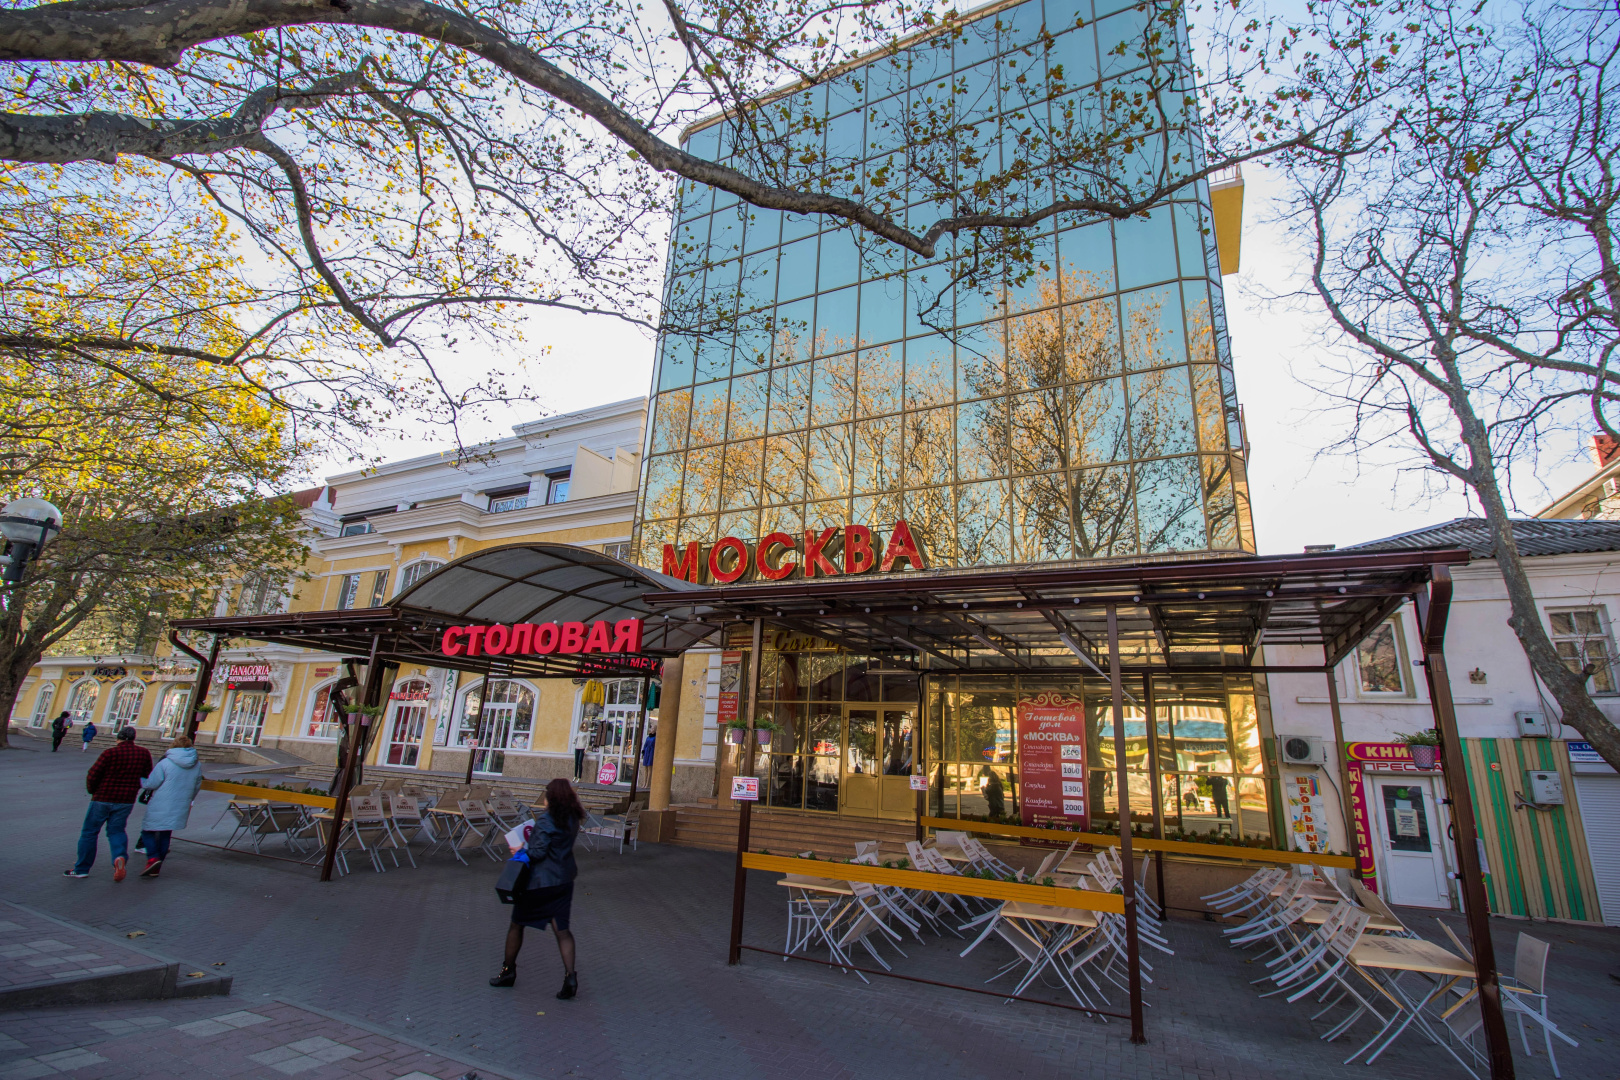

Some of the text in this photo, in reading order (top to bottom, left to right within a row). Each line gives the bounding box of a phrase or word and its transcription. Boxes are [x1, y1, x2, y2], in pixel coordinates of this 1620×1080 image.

[661, 520, 929, 584] МОСКВА
[442, 619, 644, 656] СТОЛОВАЯ
[229, 665, 269, 675] FANAGORIA
[389, 692, 429, 700] SUNLIGHT
[1024, 712, 1076, 722] Гостевой
[1038, 721, 1061, 730] дом
[1023, 732, 1080, 742] «МОСКВА»
[600, 773, 615, 782] 50%
[1064, 785, 1081, 793] 1300
[1065, 804, 1082, 812] 2000
